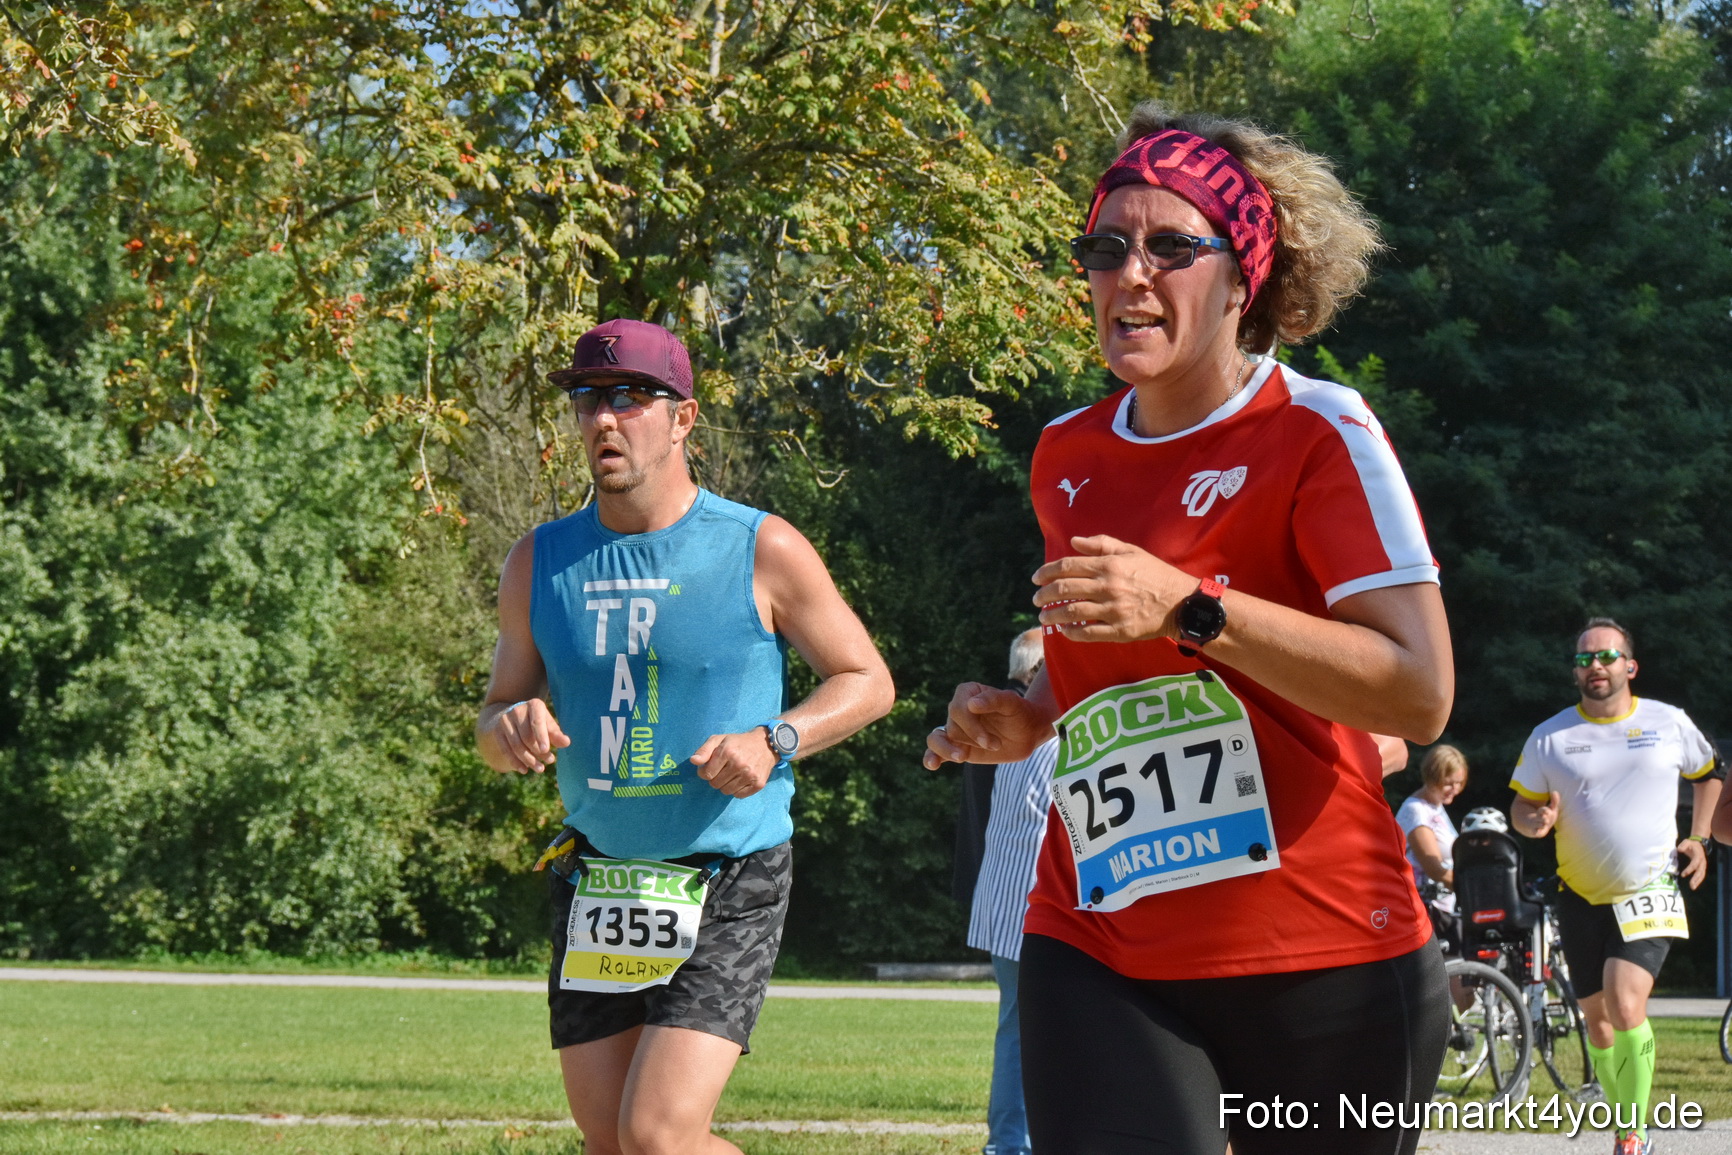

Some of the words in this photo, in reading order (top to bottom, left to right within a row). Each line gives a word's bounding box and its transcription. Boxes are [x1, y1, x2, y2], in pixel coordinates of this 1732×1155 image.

[1067, 683, 1218, 764] BOCK
[1232, 739, 1243, 751] D
[631, 726, 654, 778] HARD
[1068, 738, 1224, 842] 2517
[1108, 828, 1221, 883] MARION
[588, 866, 688, 901] BOCK
[586, 906, 679, 949] 1353
